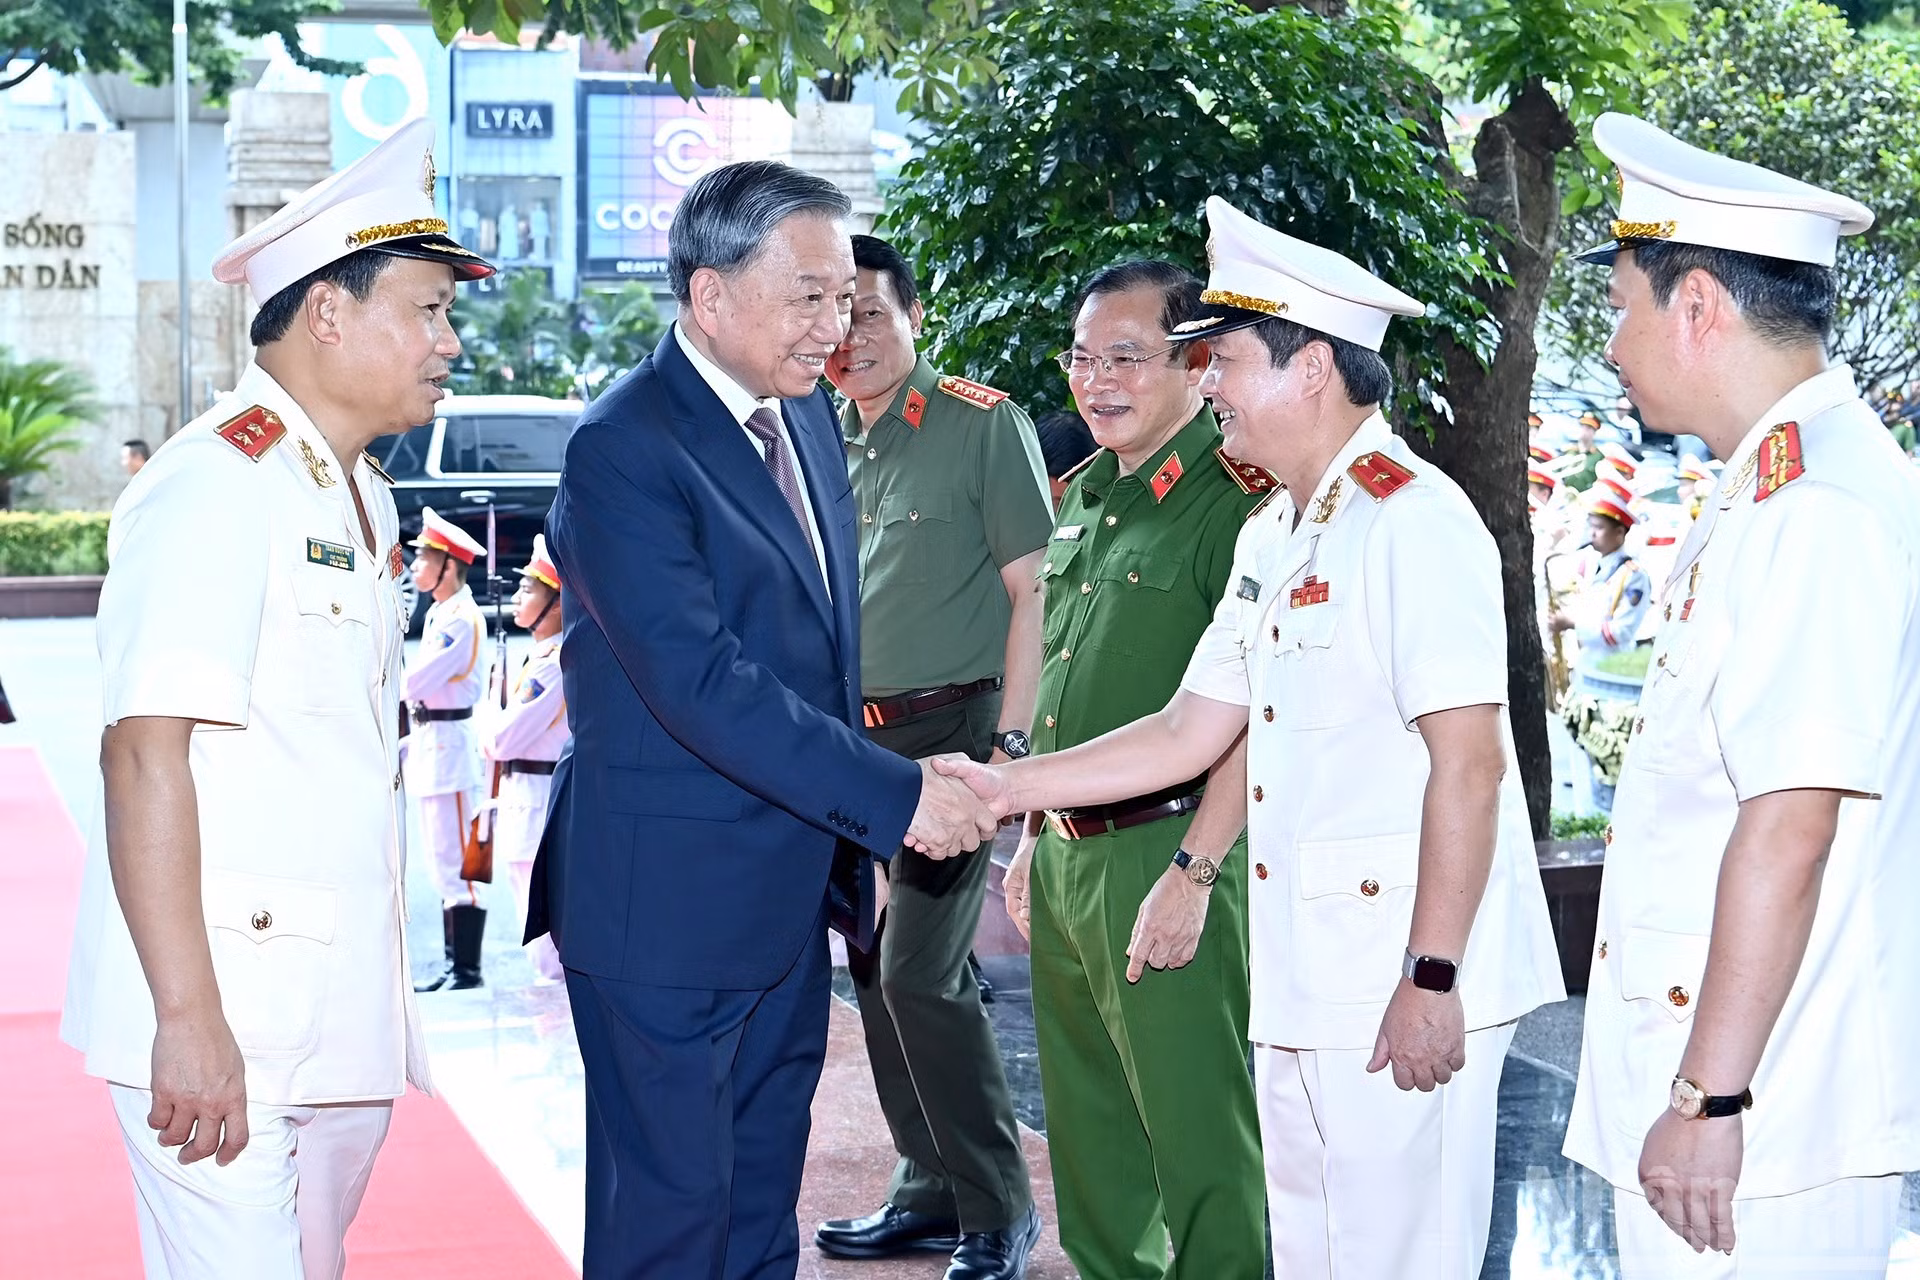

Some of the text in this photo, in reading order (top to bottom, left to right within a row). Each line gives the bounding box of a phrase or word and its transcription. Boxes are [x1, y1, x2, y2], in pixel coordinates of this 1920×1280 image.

[477, 108, 544, 131] LYRA
[4, 212, 85, 249] SỐNG
[595, 203, 673, 231] COC
[0, 258, 101, 289] N DÂN
